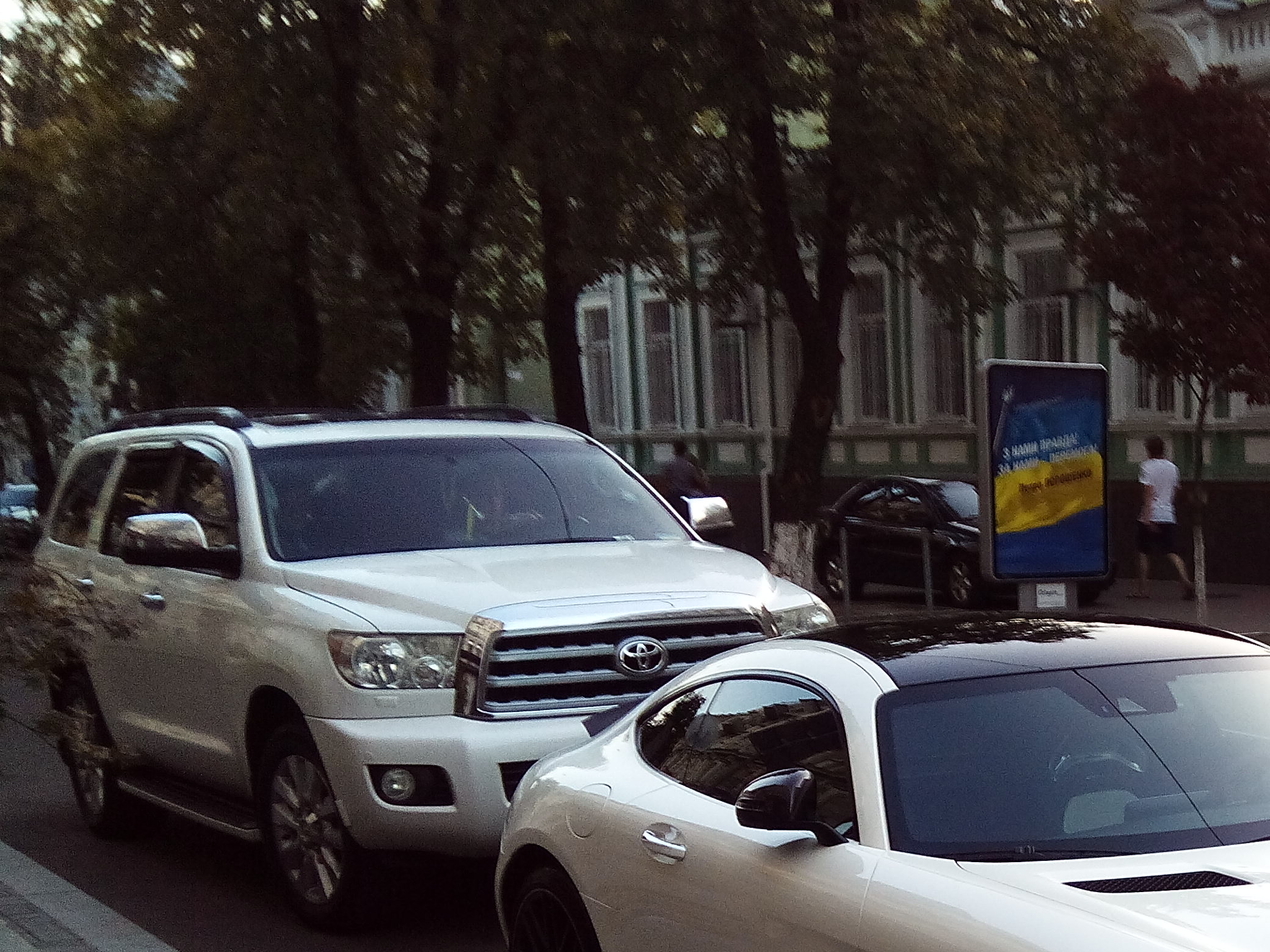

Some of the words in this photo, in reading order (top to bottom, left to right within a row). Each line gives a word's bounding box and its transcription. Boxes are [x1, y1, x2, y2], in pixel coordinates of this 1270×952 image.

[1003, 446, 1012, 460] З
[1012, 440, 1039, 457] НАМИ
[1039, 432, 1079, 450] ПРАВДА!
